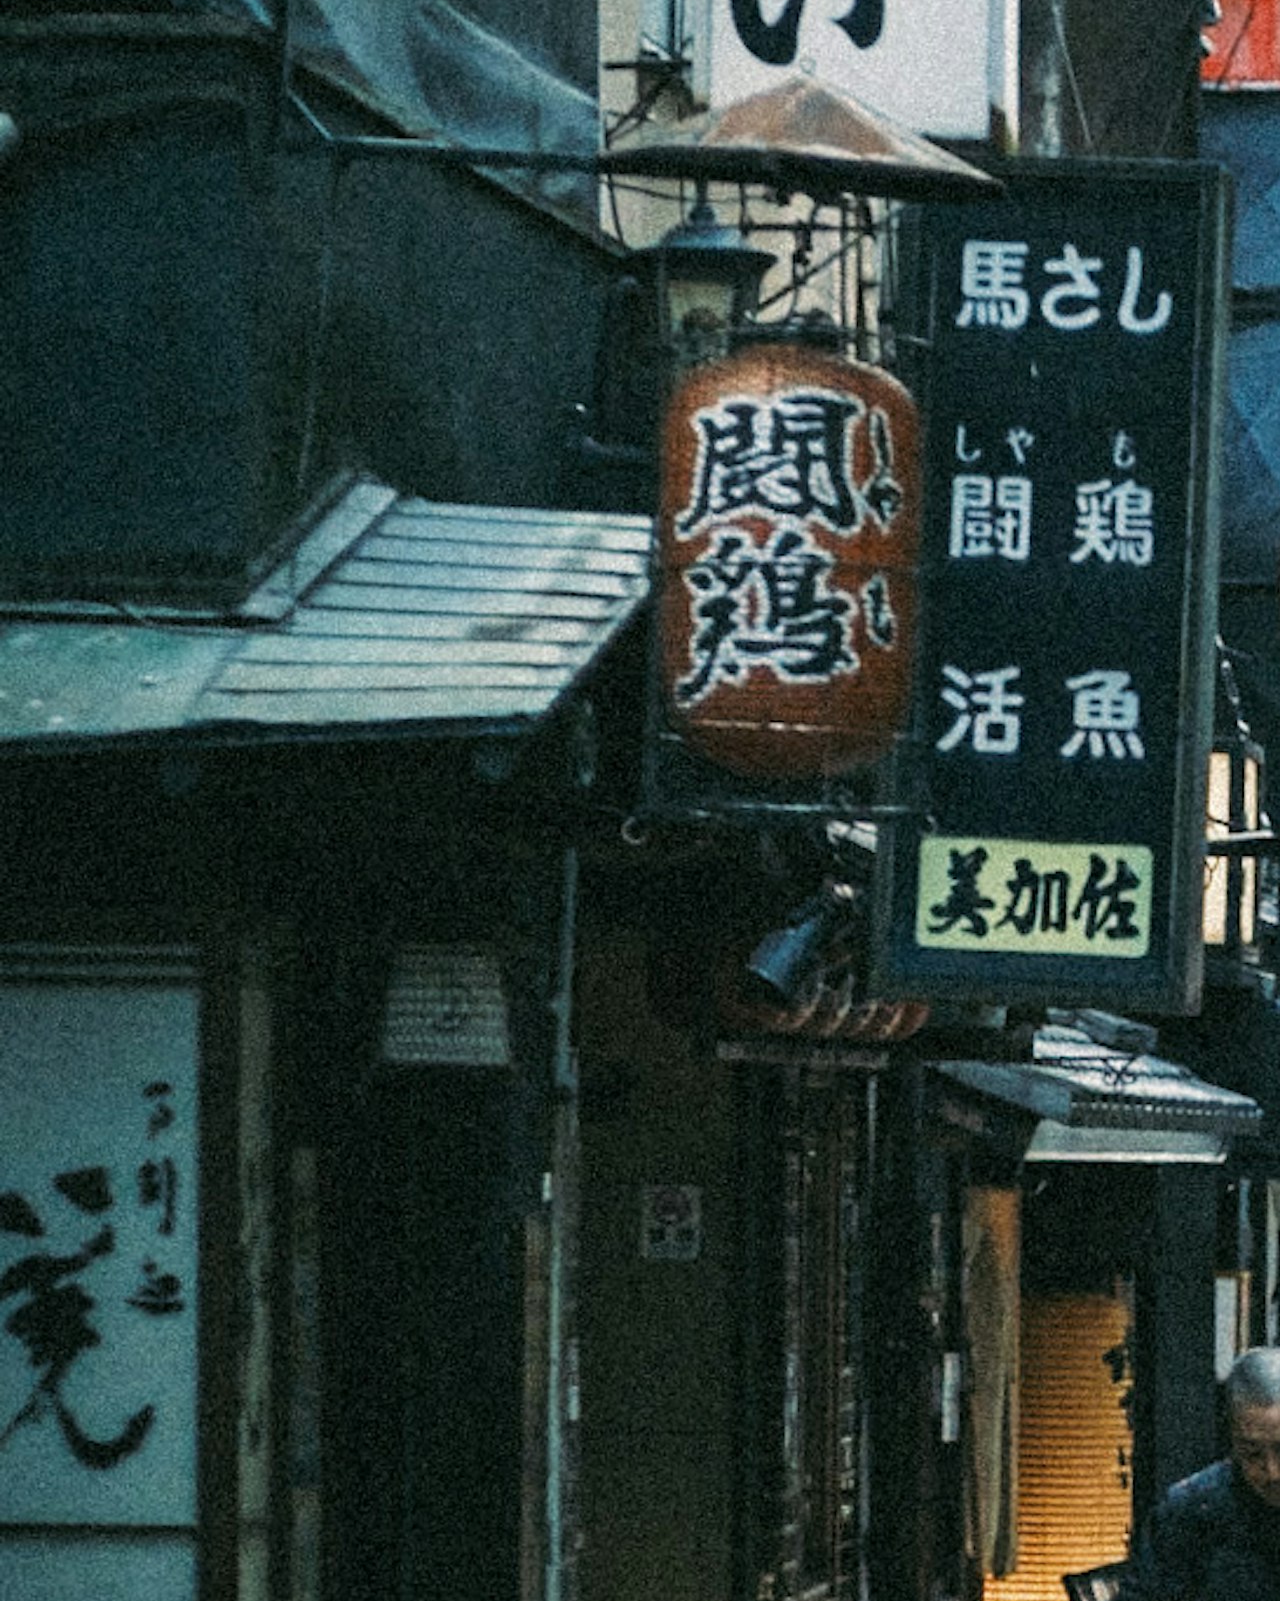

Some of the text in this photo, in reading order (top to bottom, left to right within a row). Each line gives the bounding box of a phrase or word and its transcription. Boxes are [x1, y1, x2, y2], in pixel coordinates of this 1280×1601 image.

[955, 240, 1173, 333] 馬さし
[949, 474, 1155, 567] 闘鶏
[934, 664, 1146, 760] 活魚
[926, 847, 1143, 941] 美加佐
